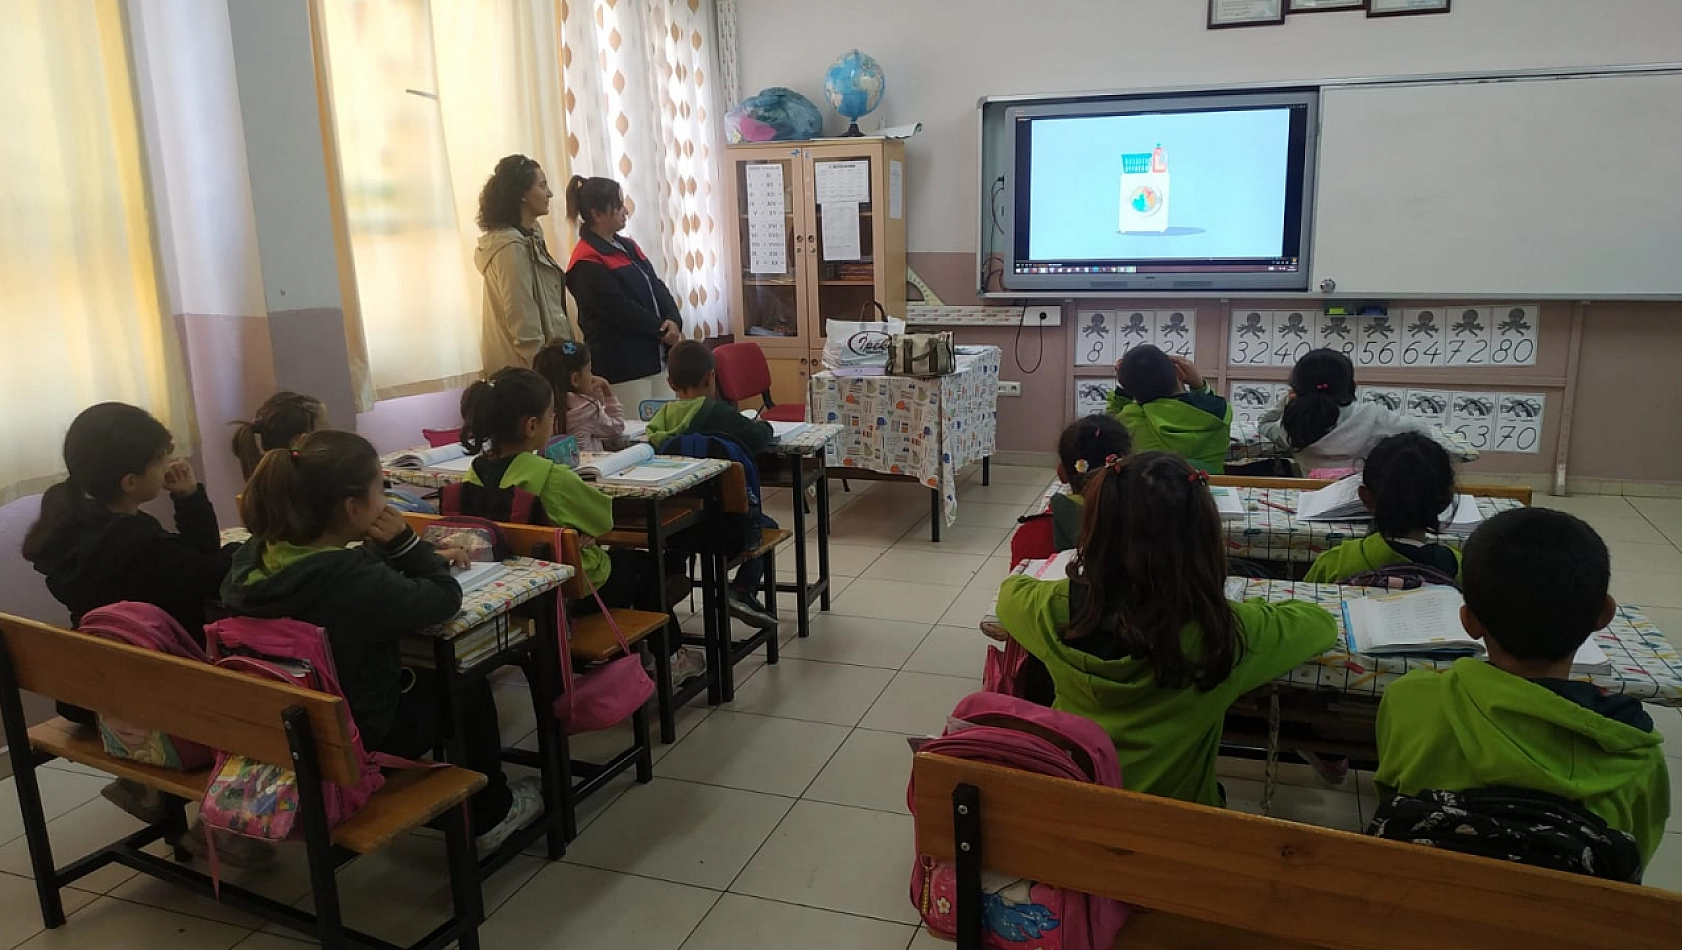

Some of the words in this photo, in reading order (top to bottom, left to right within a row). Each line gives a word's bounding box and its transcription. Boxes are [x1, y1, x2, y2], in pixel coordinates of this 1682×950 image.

[1086, 341, 1104, 362] 8
[1231, 341, 1269, 364] 32
[1273, 341, 1312, 364] 40
[1359, 341, 1397, 365] 56
[1403, 341, 1442, 365] 64
[1446, 339, 1488, 364] 72
[1492, 338, 1534, 364] 80
[1496, 425, 1537, 450] 70
